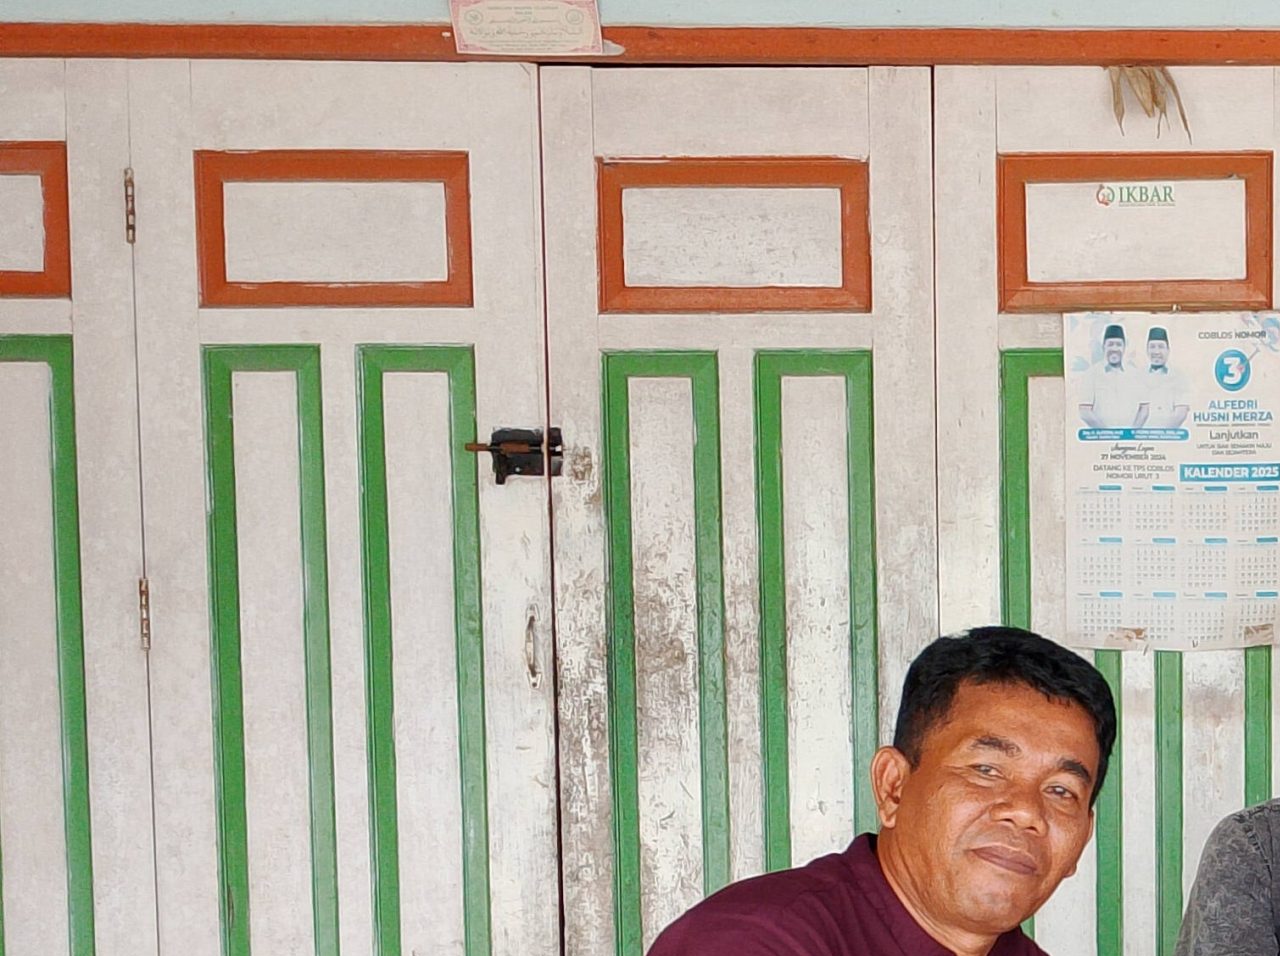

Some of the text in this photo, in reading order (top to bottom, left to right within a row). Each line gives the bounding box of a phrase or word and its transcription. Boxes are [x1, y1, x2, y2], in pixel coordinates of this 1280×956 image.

[1119, 186, 1174, 202] IKBAR
[1234, 331, 1267, 339] NOMOR
[1223, 357, 1245, 385] 3
[1208, 400, 1257, 410] ALFEDRI
[1193, 411, 1273, 422] HUSNI MERZA
[1209, 430, 1259, 442] Lanjutkan
[1184, 466, 1279, 478] KALENDER 2025
